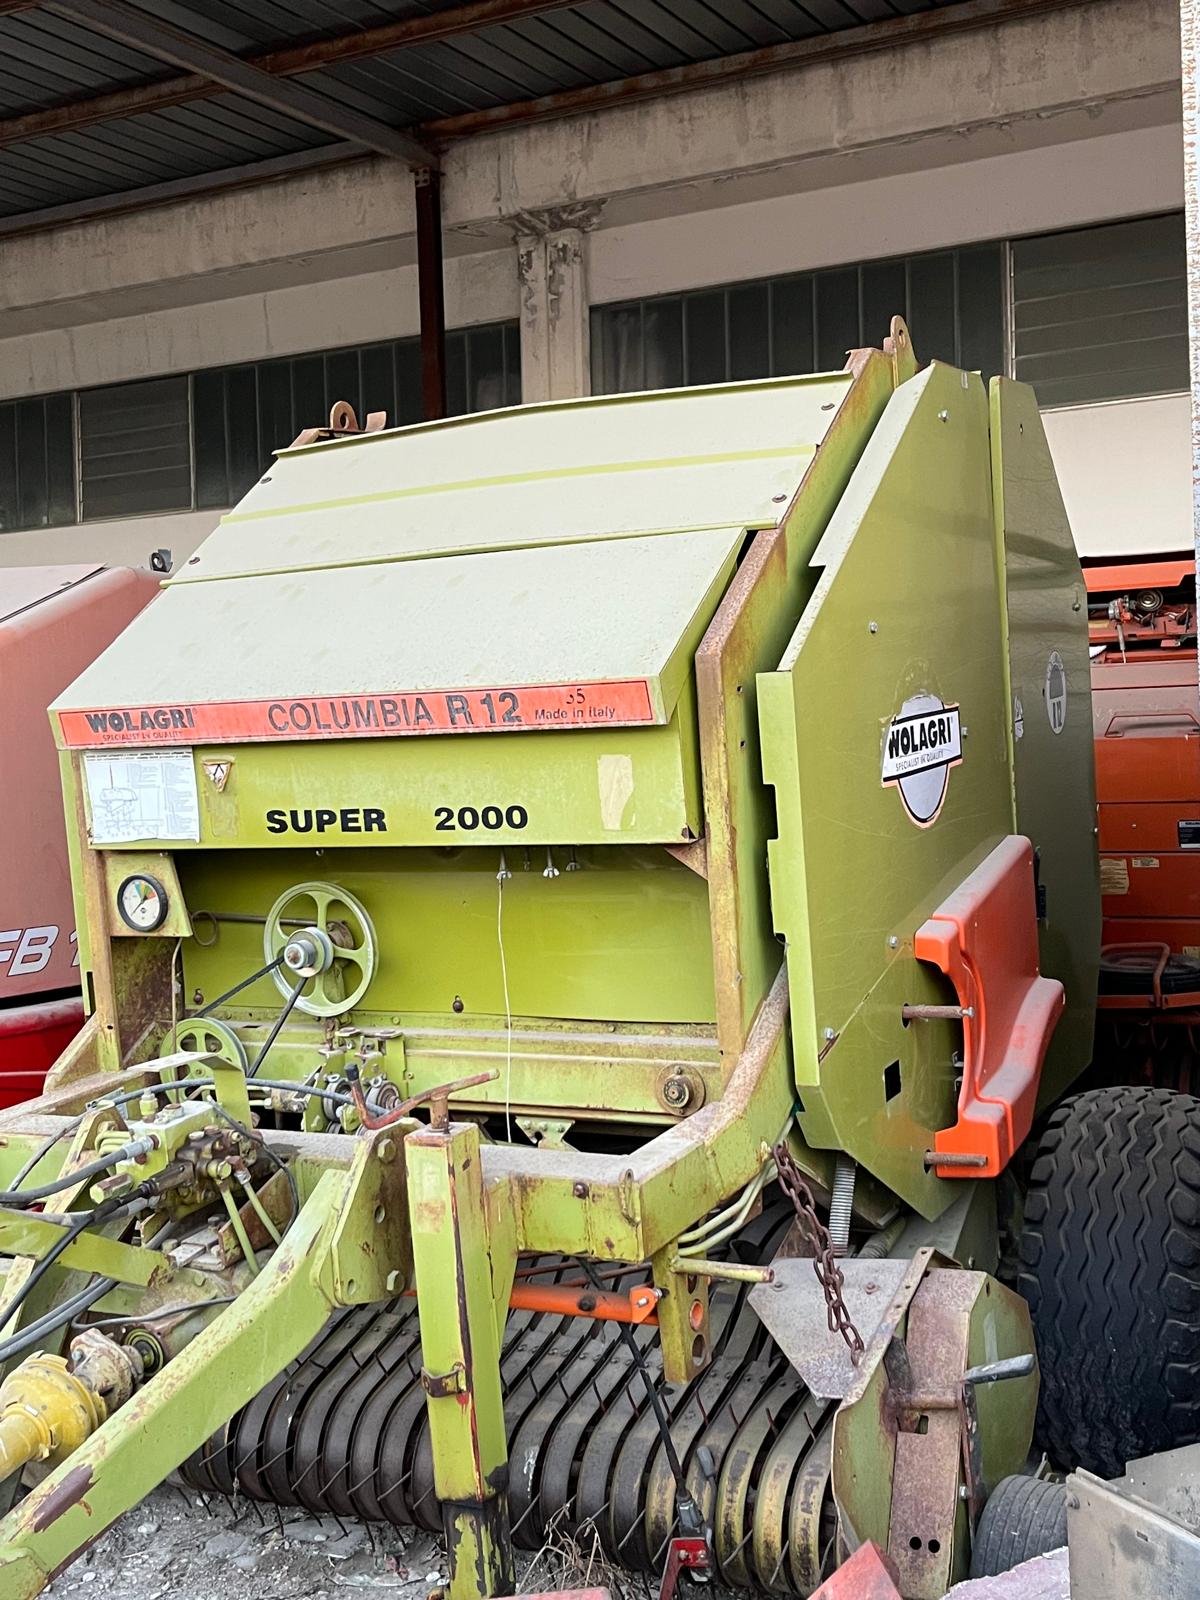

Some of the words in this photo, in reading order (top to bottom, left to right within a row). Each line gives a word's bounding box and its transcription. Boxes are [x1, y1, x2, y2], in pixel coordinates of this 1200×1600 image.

[85, 708, 195, 733] WOLAGRI
[267, 697, 435, 732] COLUMBIA
[445, 694, 474, 726] R
[480, 691, 522, 724] 12
[535, 708, 568, 720] Made
[572, 708, 584, 718] in
[589, 706, 616, 719] Italy
[888, 716, 952, 759] WOLAGRI
[895, 757, 919, 772] SPECIALIST
[926, 748, 944, 763] QUALITY
[266, 808, 388, 834] SUPER
[434, 805, 529, 831] 2000
